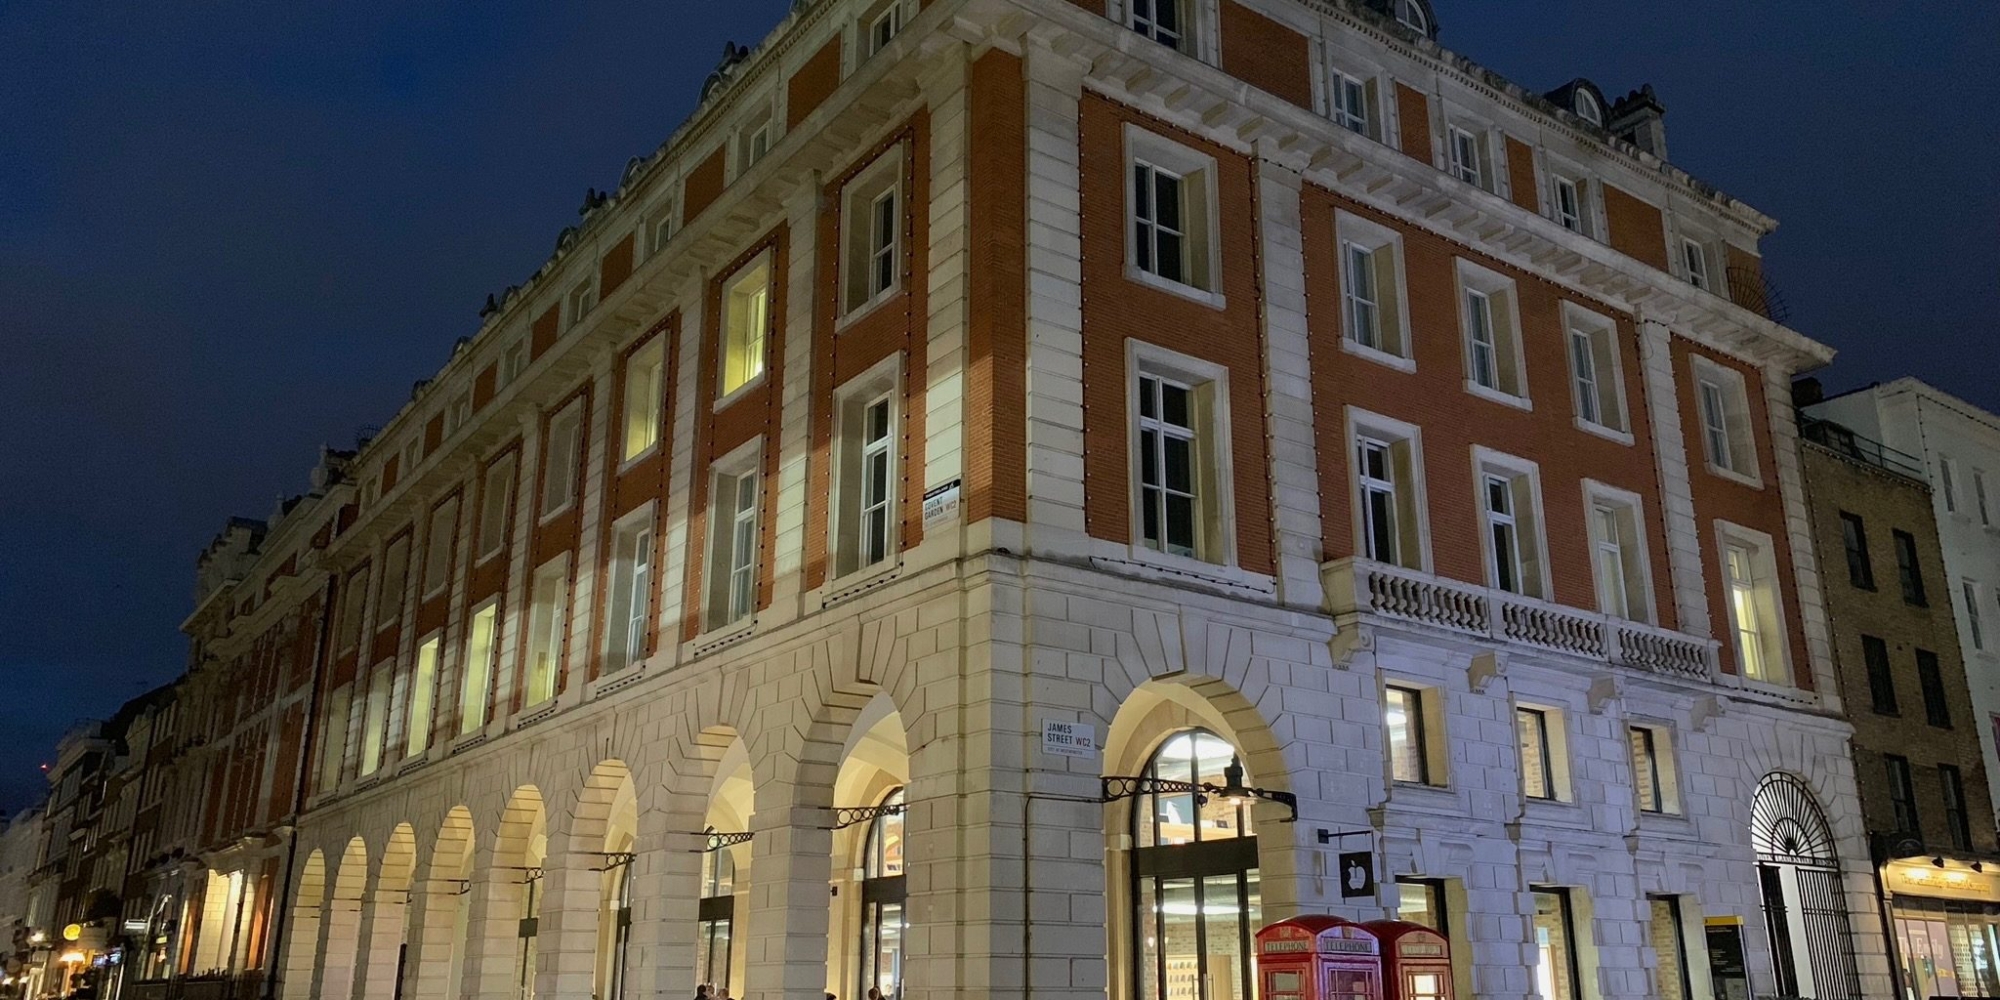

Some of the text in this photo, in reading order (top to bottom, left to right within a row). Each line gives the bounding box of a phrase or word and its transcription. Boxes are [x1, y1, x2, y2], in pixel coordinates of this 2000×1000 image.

[925, 497, 943, 511] COVENT
[925, 500, 956, 520] GARDEN WC2
[1048, 723, 1072, 734] JAMES
[1048, 733, 1090, 747] STREET WC2
[1266, 941, 1307, 952] TELEPHONE
[1325, 942, 1372, 953] TELEPHONE
